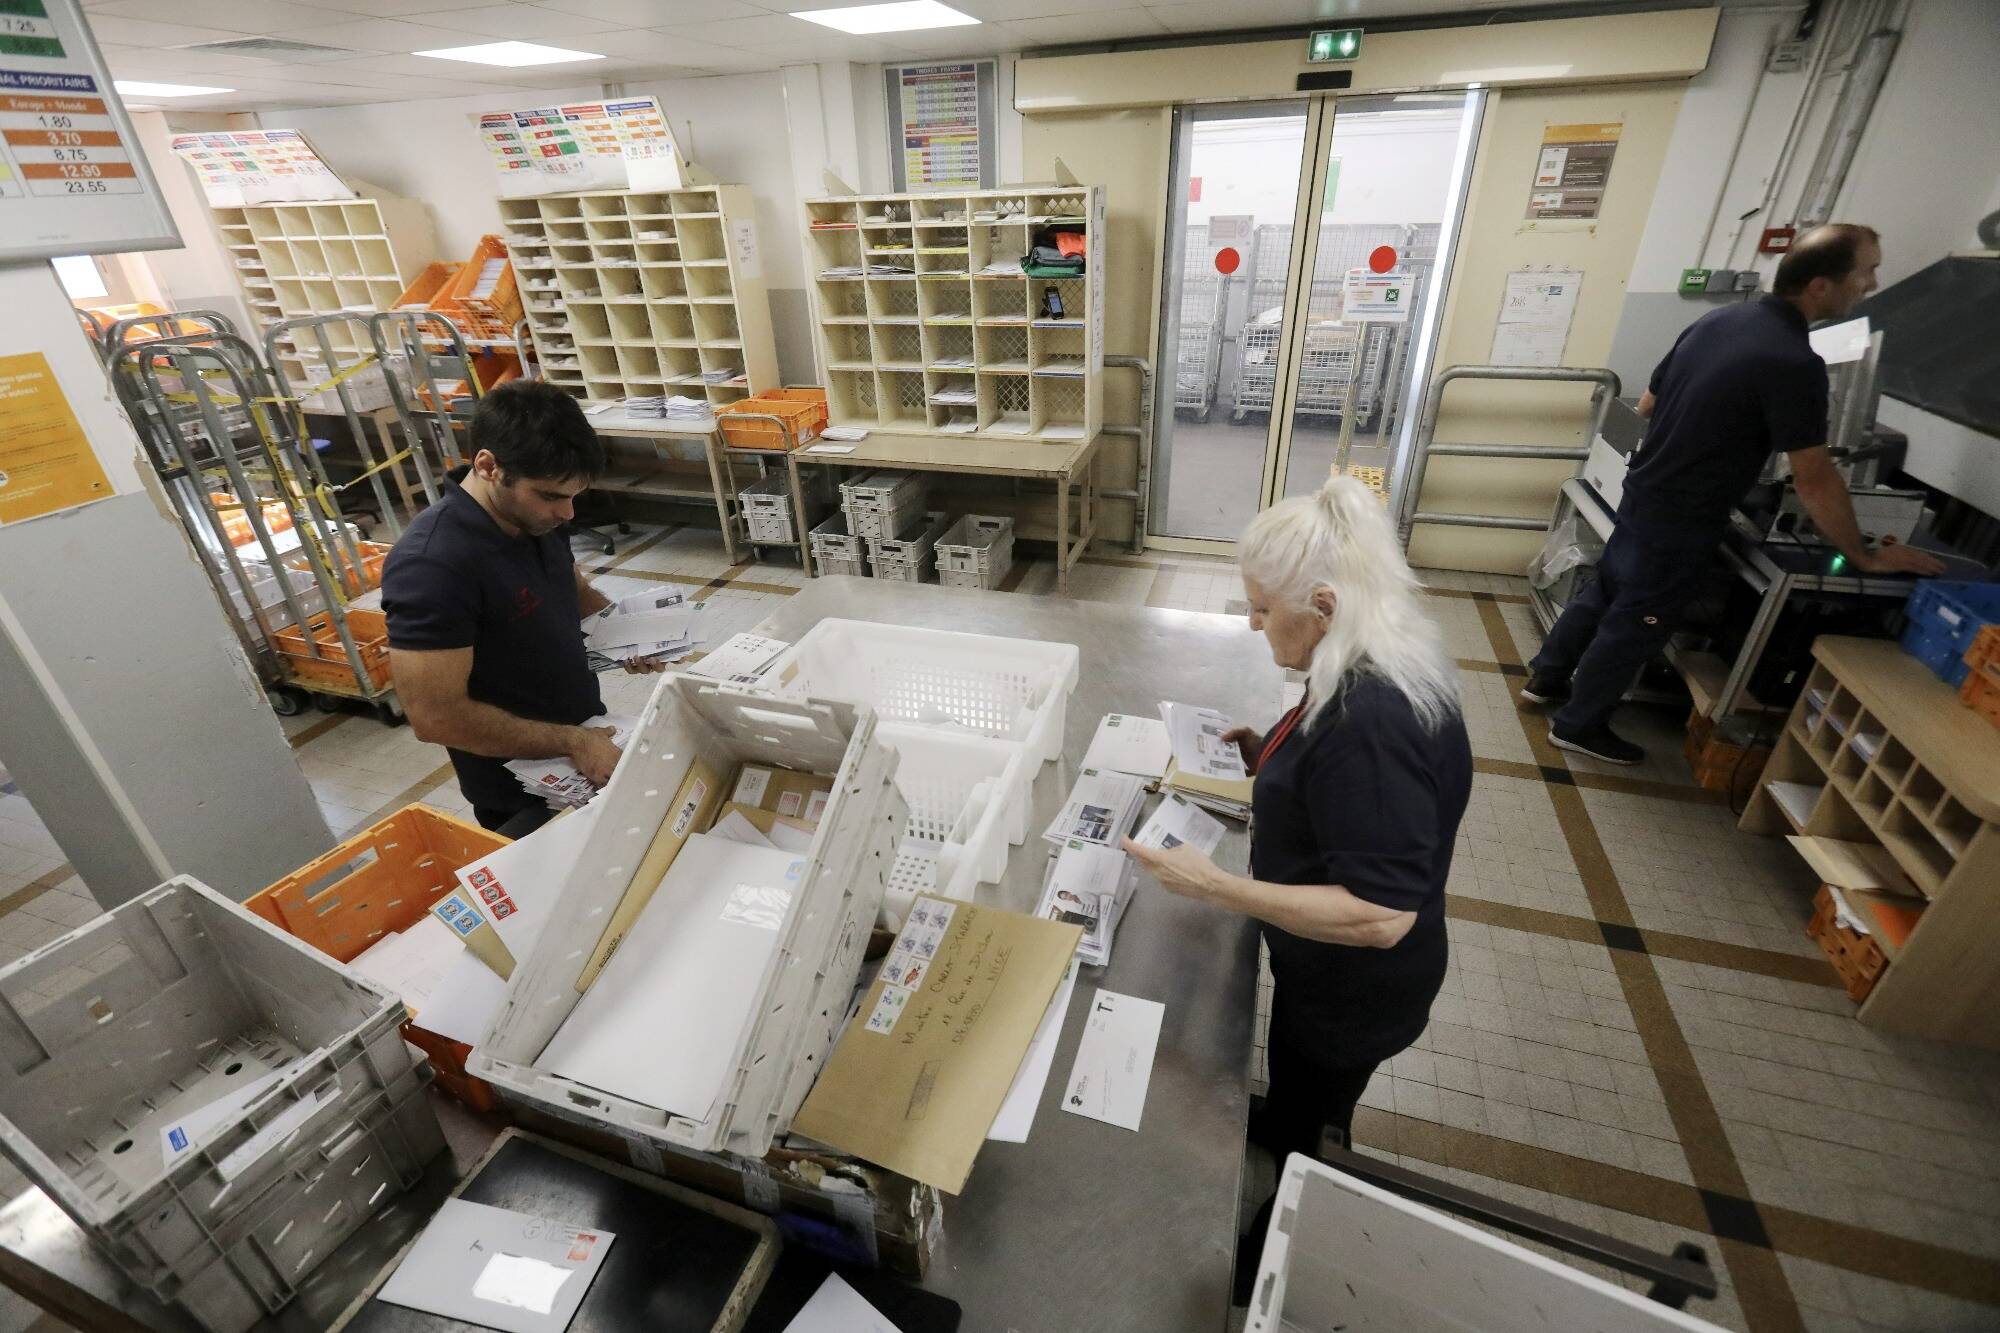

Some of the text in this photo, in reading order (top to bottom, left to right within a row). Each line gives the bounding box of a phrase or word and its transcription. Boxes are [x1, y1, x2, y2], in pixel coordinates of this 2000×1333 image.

[19, 74, 91, 89] PRIORITAIRE
[39, 115, 72, 128] 1.80
[53, 149, 88, 161] 8.75
[65, 181, 107, 193] 23.55
[1097, 1002, 1111, 1012] T
